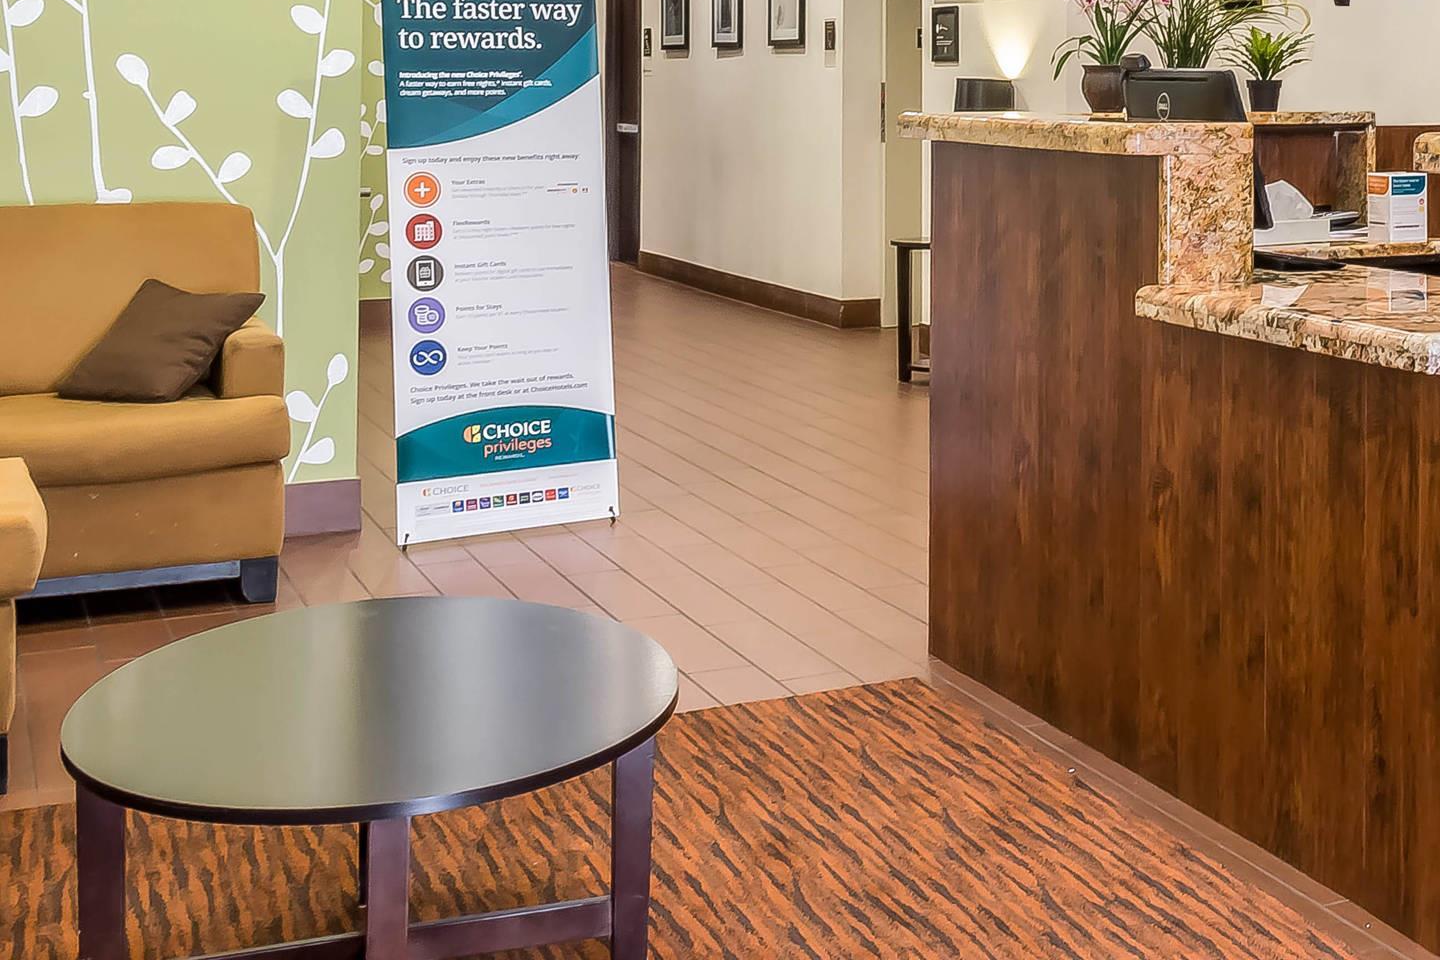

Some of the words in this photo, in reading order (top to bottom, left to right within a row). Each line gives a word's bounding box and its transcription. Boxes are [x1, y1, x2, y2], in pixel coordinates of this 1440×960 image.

[529, 3, 582, 27] way
[398, 28, 424, 49] to
[430, 26, 543, 50] rewards.
[399, 71, 438, 80] Introducing
[402, 157, 417, 165] Sign
[428, 157, 448, 165] today
[463, 156, 481, 164] enjoy
[517, 153, 544, 161] benefits
[545, 153, 560, 161] right
[410, 397, 425, 405] Sign
[437, 394, 457, 402] today
[483, 419, 552, 441] CHOICE
[484, 437, 553, 458] privileges
[432, 484, 470, 496] CHOICE
